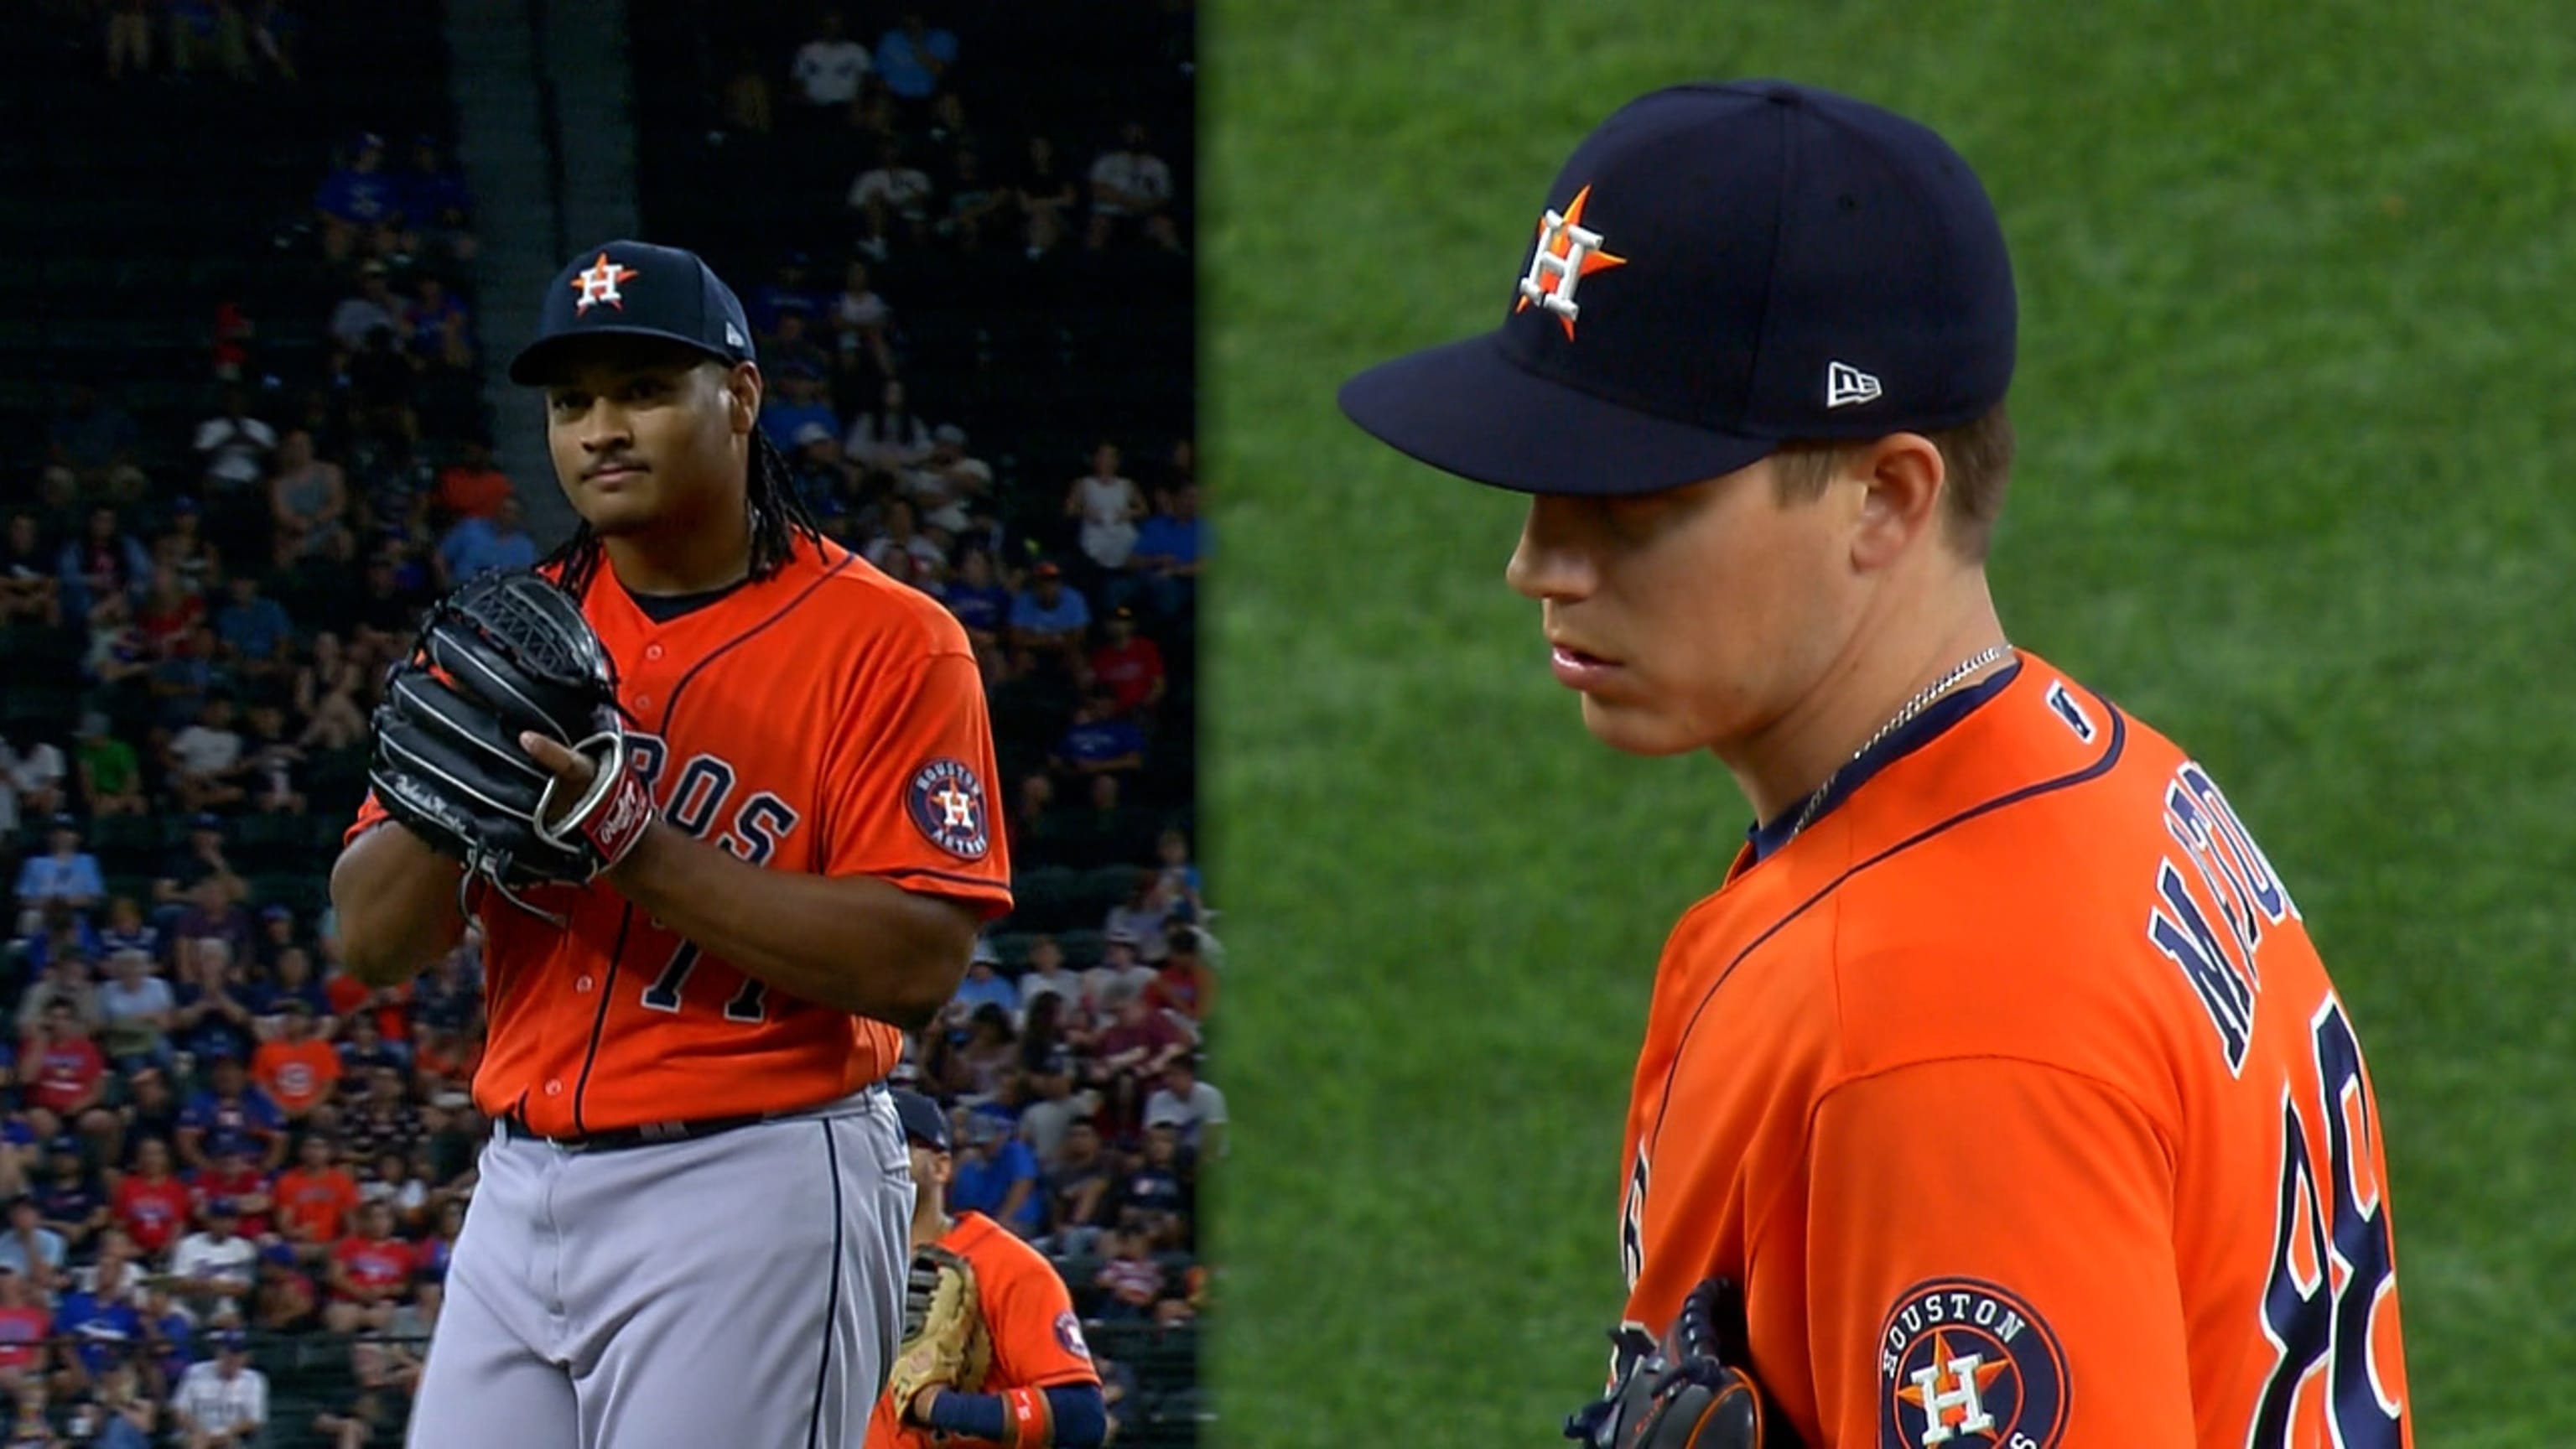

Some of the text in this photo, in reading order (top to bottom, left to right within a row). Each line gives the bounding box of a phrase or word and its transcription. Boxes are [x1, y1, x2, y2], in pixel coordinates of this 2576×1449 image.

[576, 264, 623, 307] H
[1519, 208, 1605, 323] H
[938, 790, 974, 828] H
[1882, 1293, 2025, 1379] HOUSTON
[1909, 1352, 1994, 1446] H
